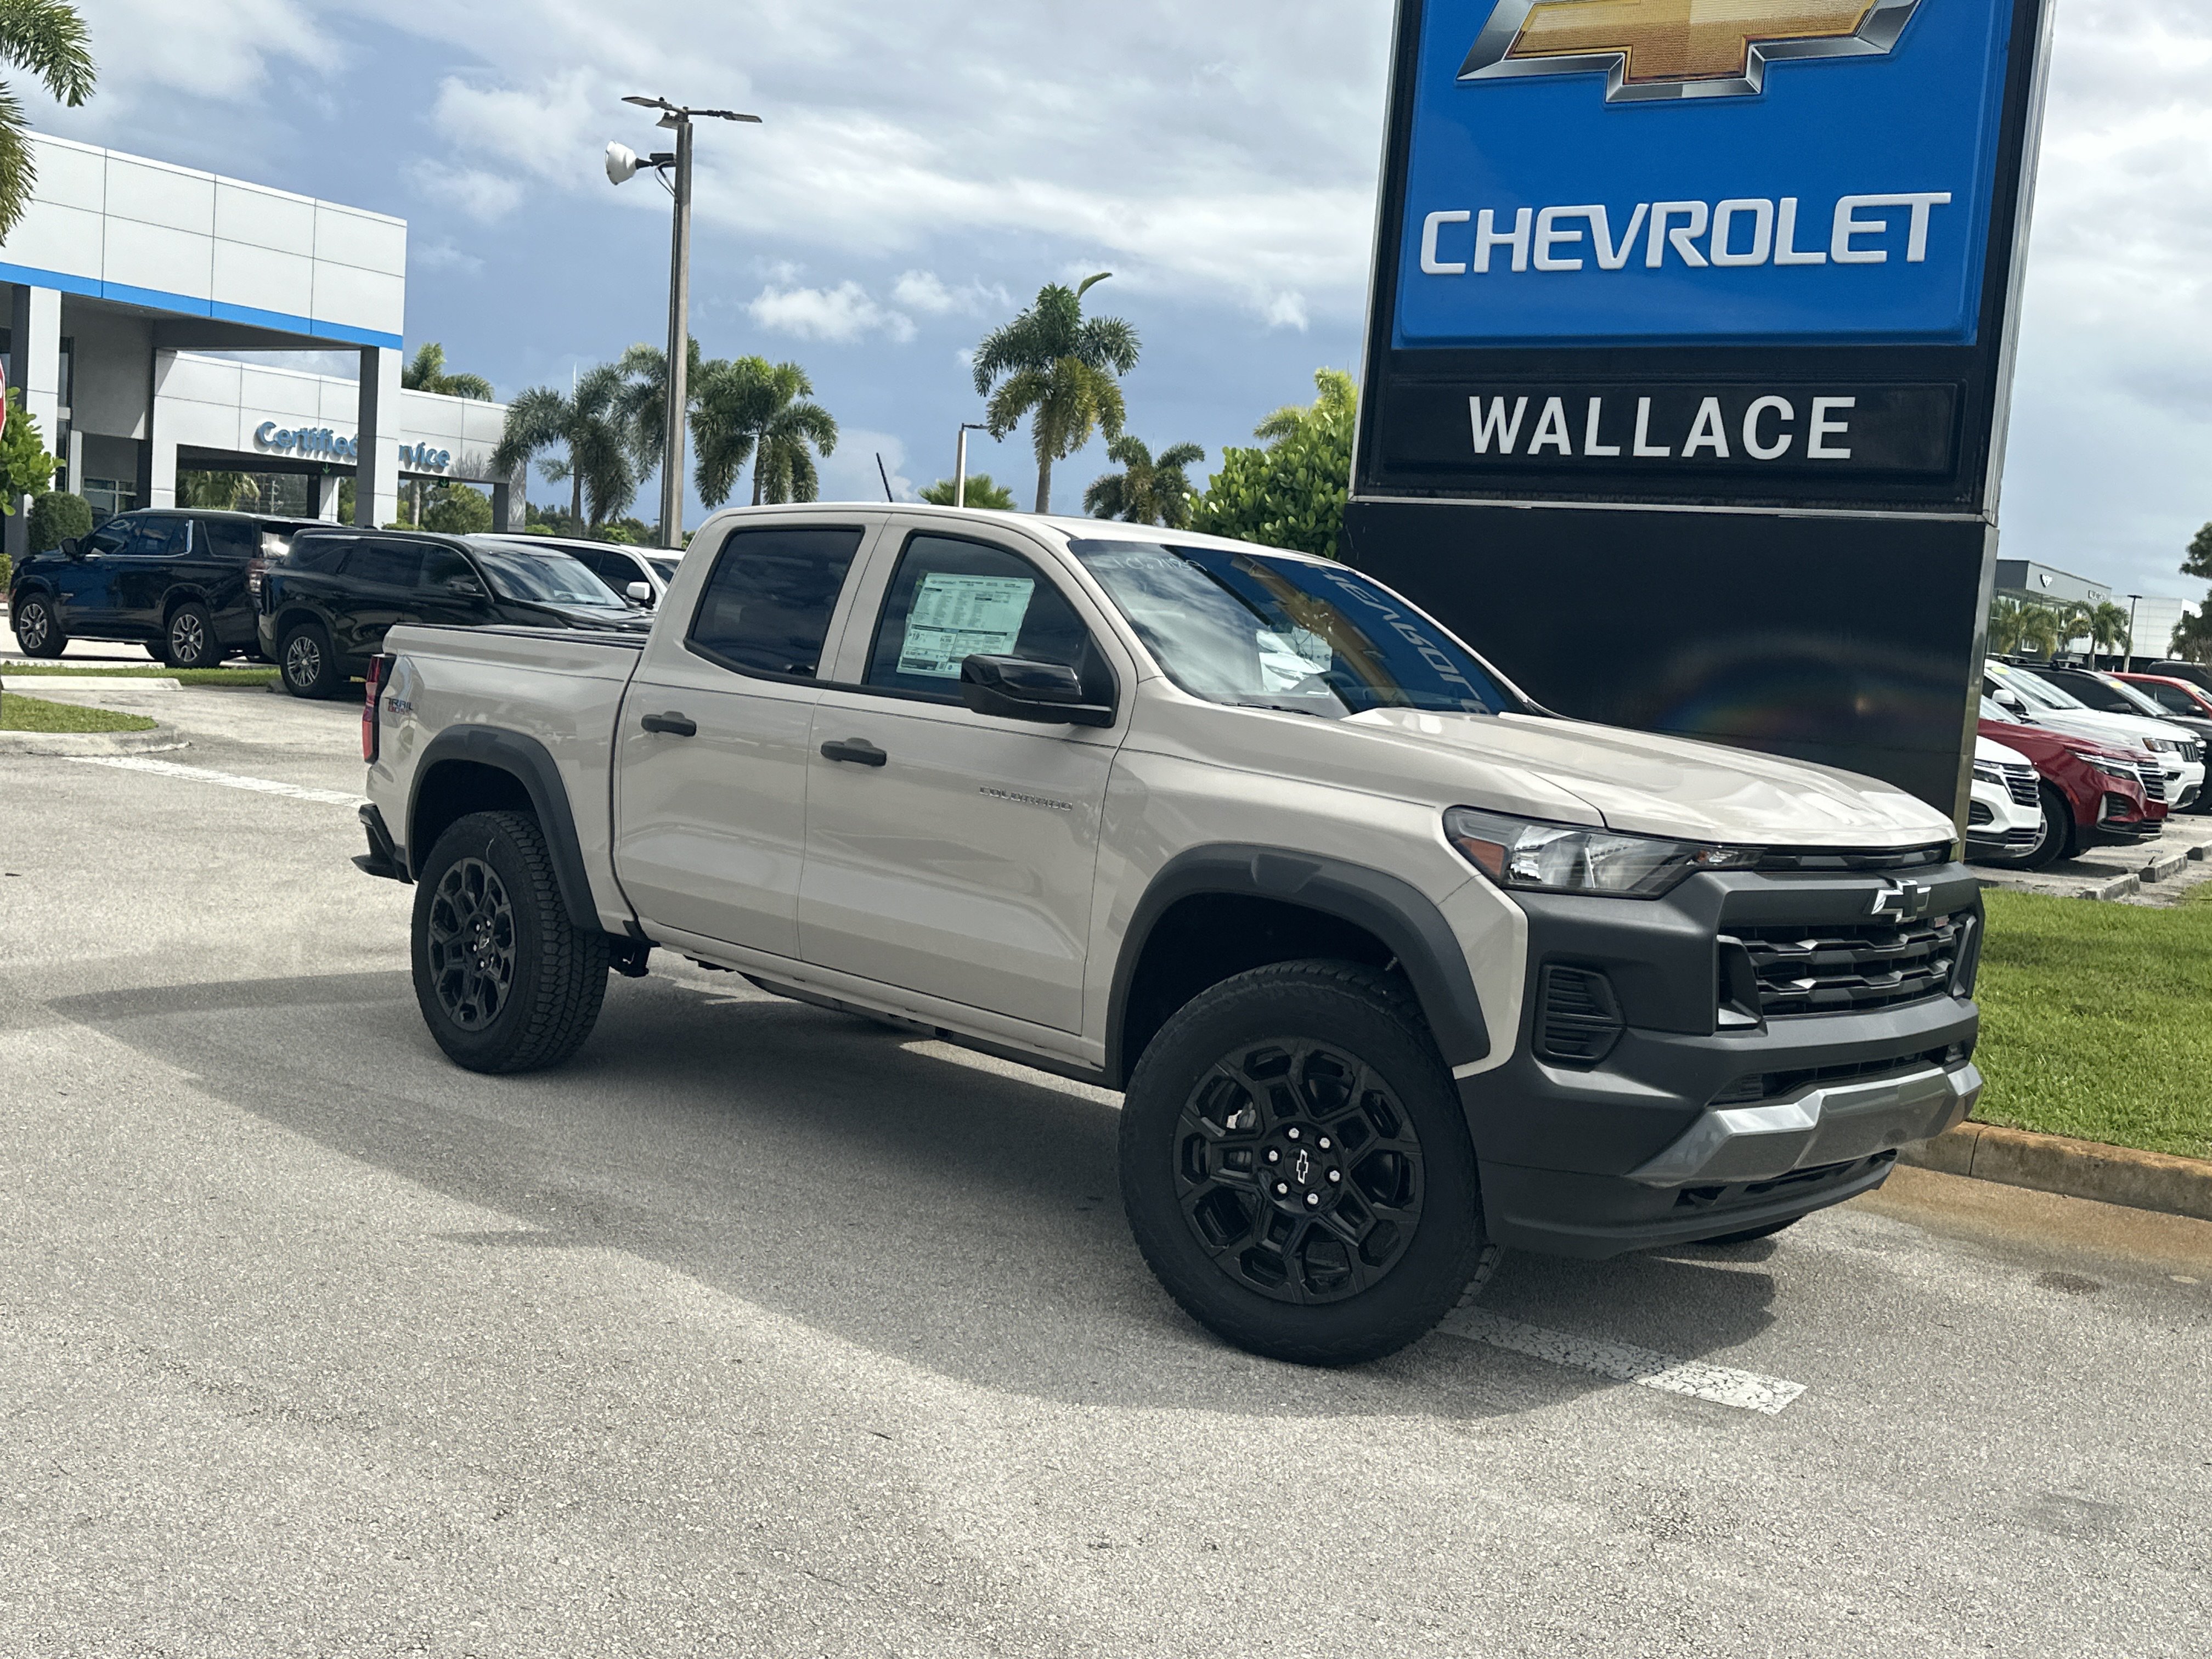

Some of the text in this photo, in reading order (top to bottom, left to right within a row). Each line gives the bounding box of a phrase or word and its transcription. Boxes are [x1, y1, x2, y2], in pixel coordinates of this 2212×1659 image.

[1420, 192, 1951, 274] CHEVROLET
[1469, 396, 1855, 460] WALLACE
[398, 441, 450, 467] rvice
[385, 697, 413, 710] TRAIL
